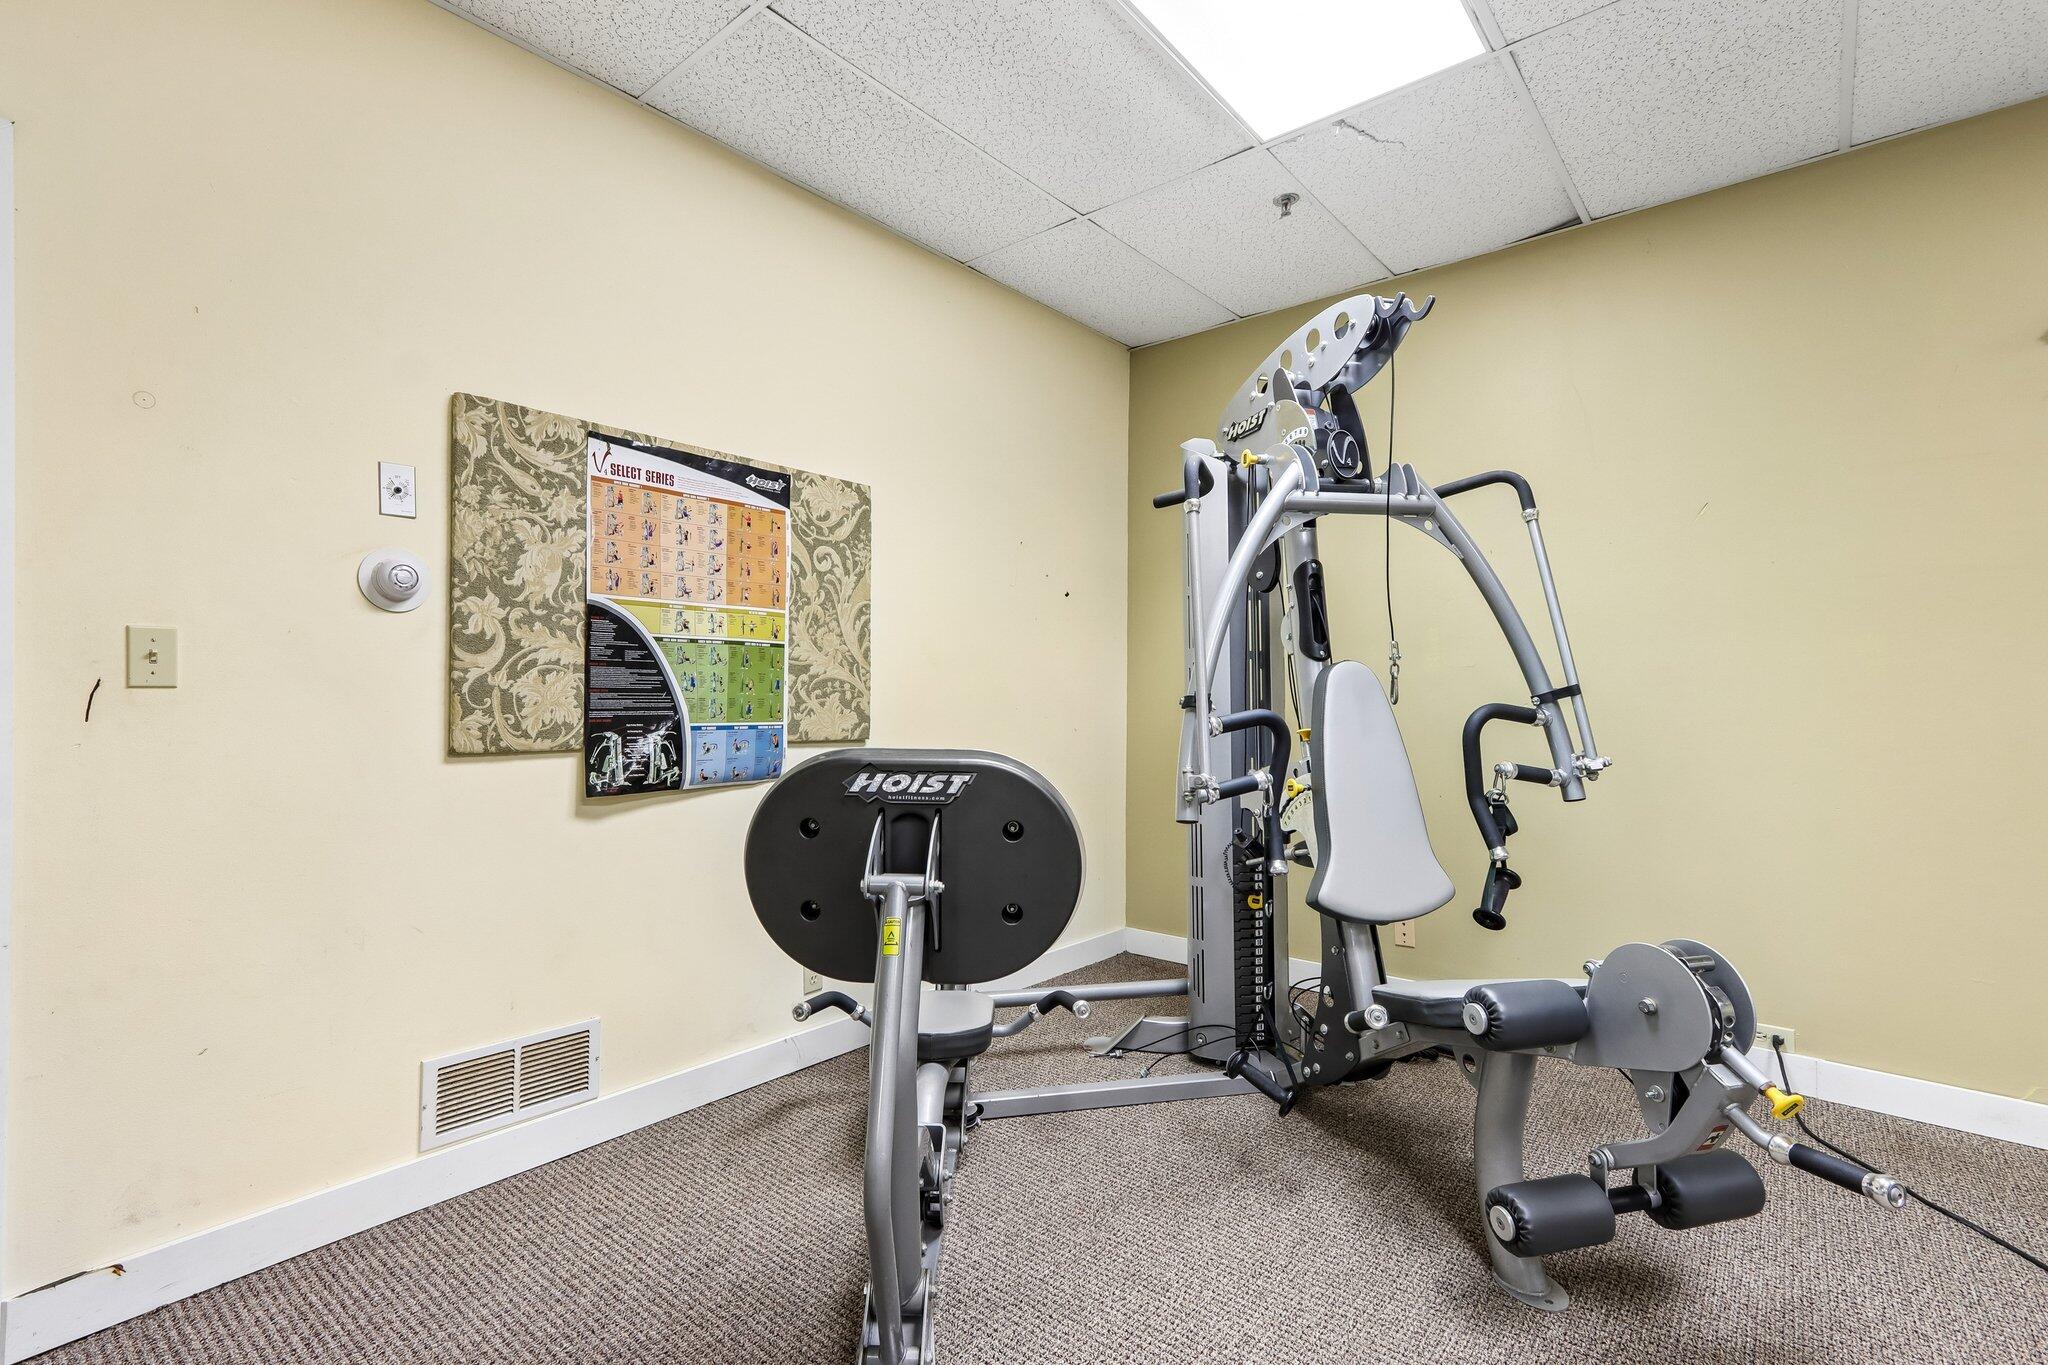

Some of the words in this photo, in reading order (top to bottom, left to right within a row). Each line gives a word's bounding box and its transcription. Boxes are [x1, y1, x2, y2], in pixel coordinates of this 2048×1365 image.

[1228, 409, 1266, 440] HOIST
[610, 462, 642, 481] SELECT
[645, 469, 675, 488] SERIES
[747, 475, 786, 491] HOIST
[848, 772, 971, 794] HOIST
